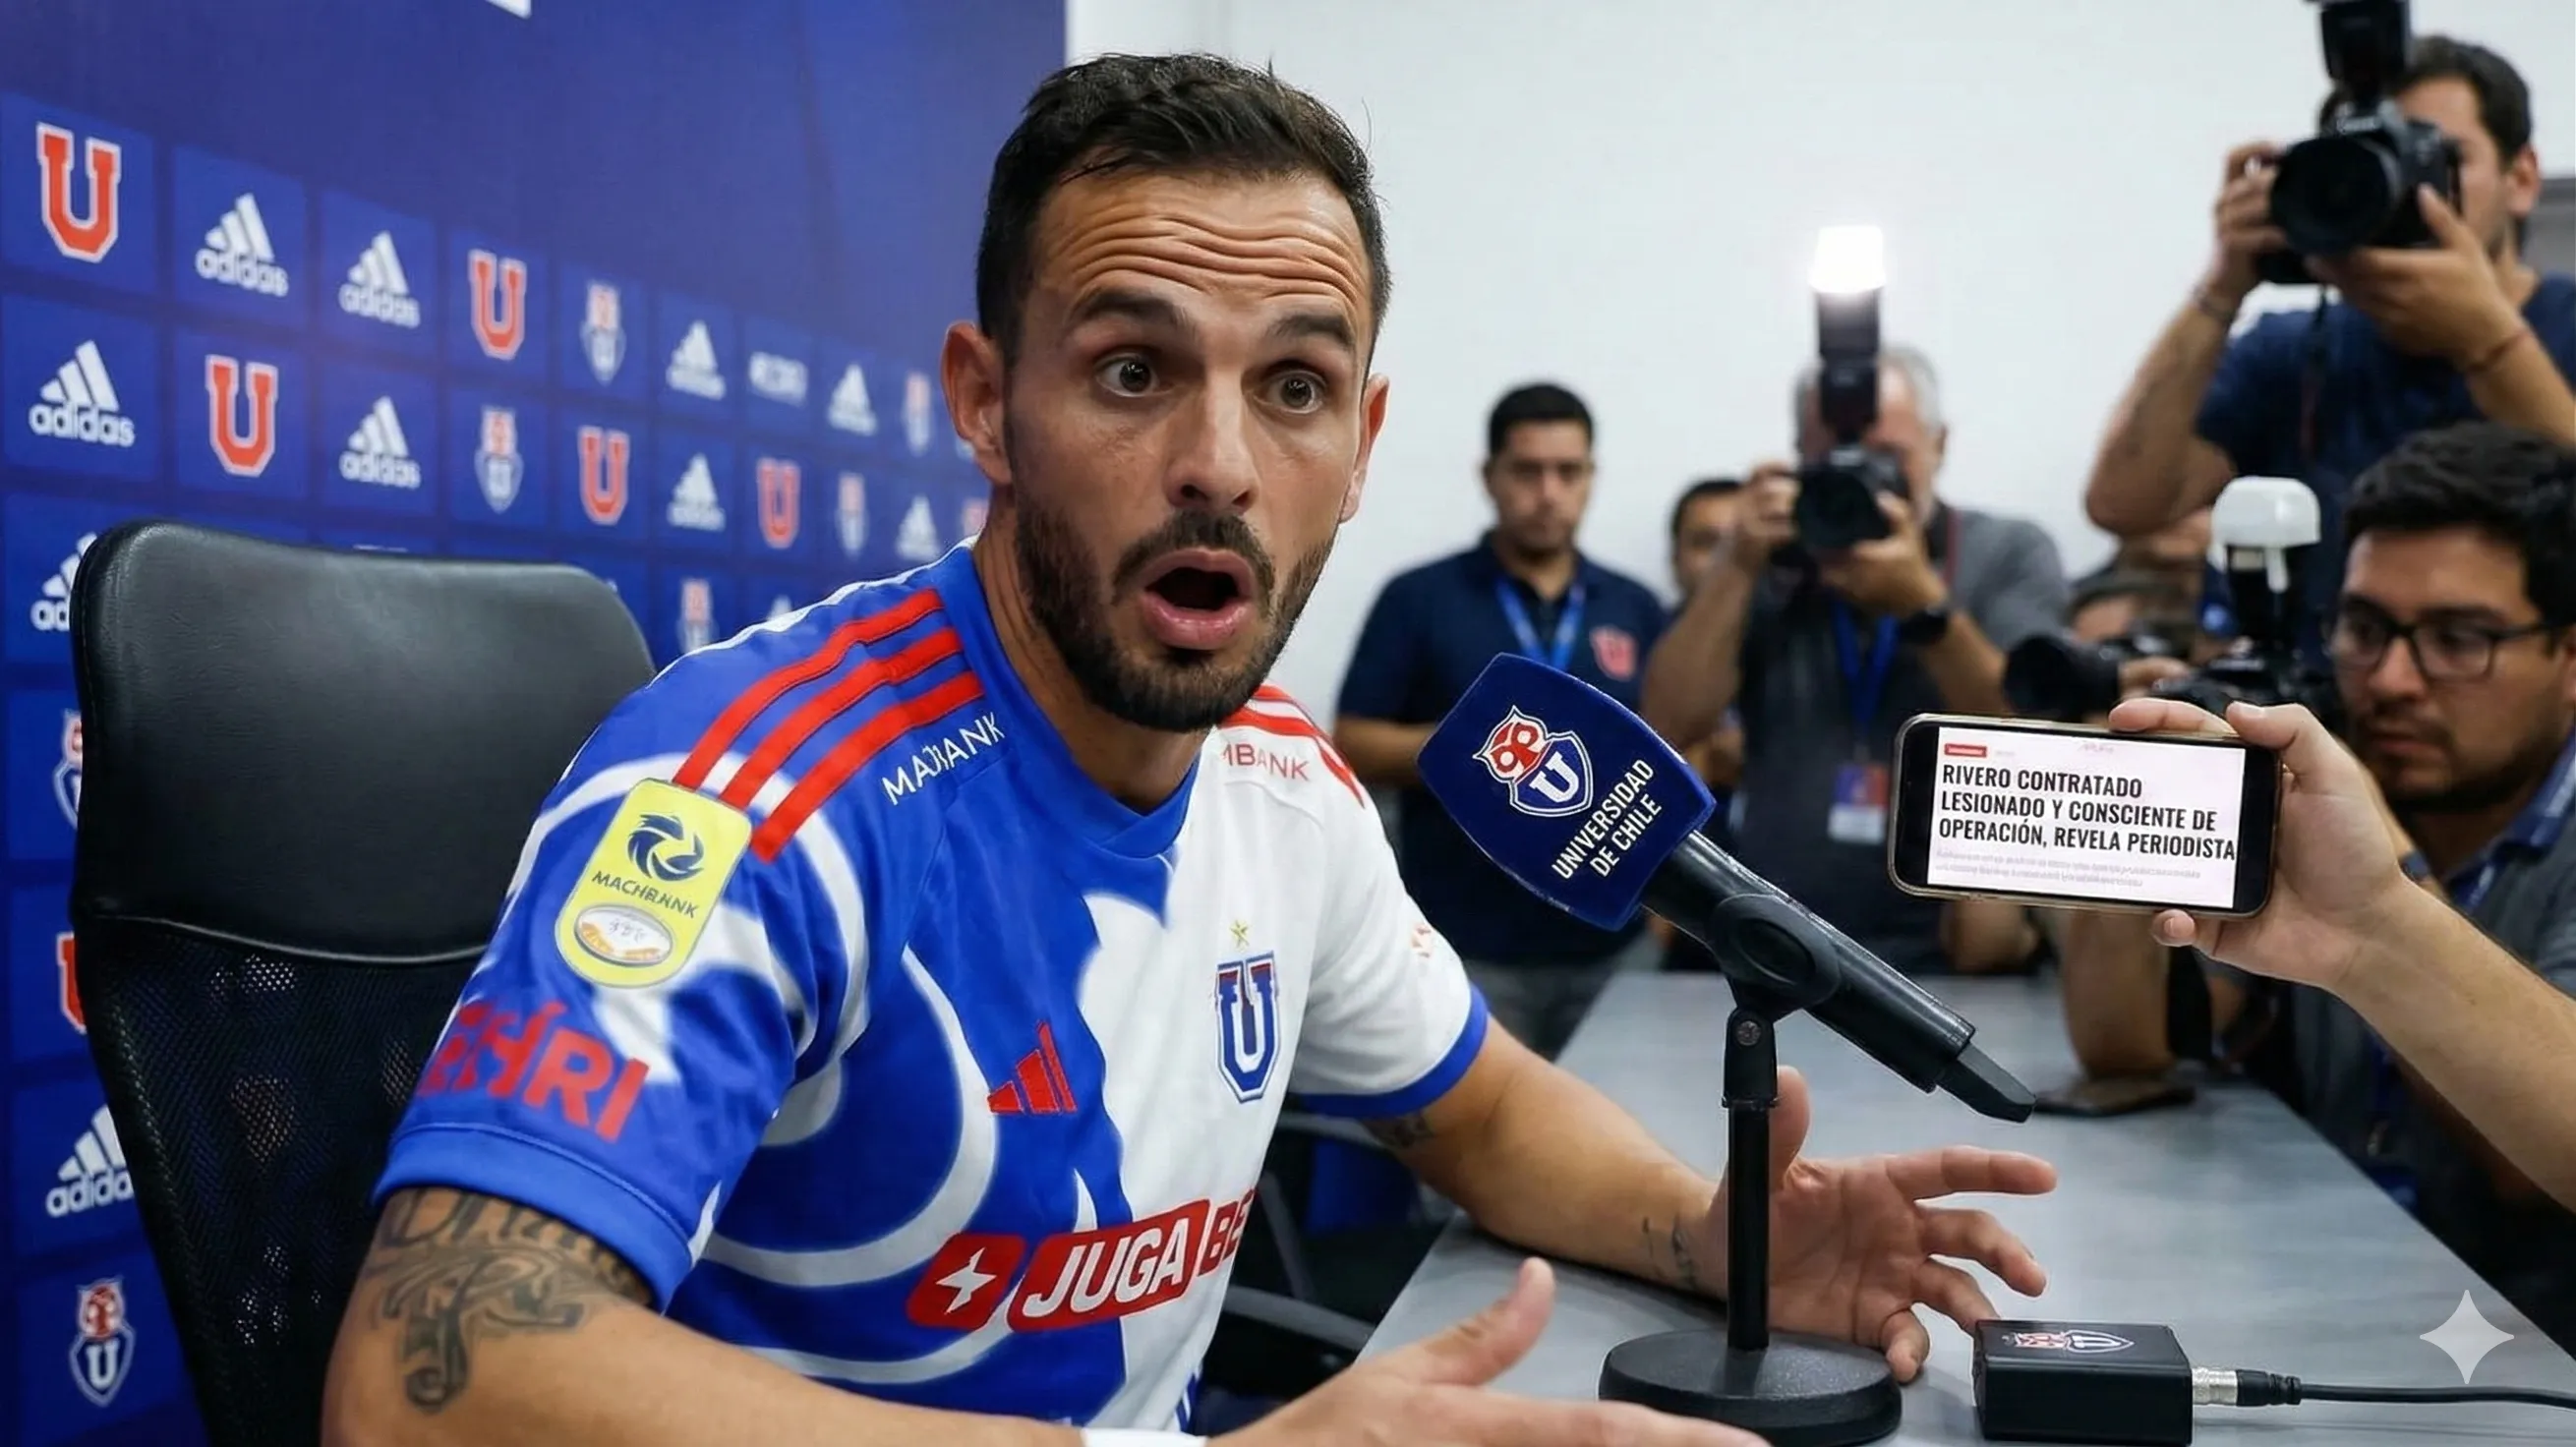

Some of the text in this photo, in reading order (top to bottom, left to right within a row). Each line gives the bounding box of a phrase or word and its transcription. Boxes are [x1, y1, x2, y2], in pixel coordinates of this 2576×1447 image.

[36, 121, 121, 262] U
[196, 249, 289, 296] adidas
[469, 249, 526, 360] U
[29, 403, 135, 447] adidas
[205, 355, 278, 477] U
[578, 426, 629, 525] U
[1942, 790, 2217, 831] LESIONADO Y CONSCIENTE DE
[1943, 765, 2142, 798] RIVERO CONTRATADO
[1551, 759, 1655, 880] UNIVERSIDAD
[1590, 793, 1663, 877] DE CHILE
[1939, 818, 2235, 860] OPERACIÓN, REVELA PERIODISTA
[46, 1171, 133, 1218] adida
